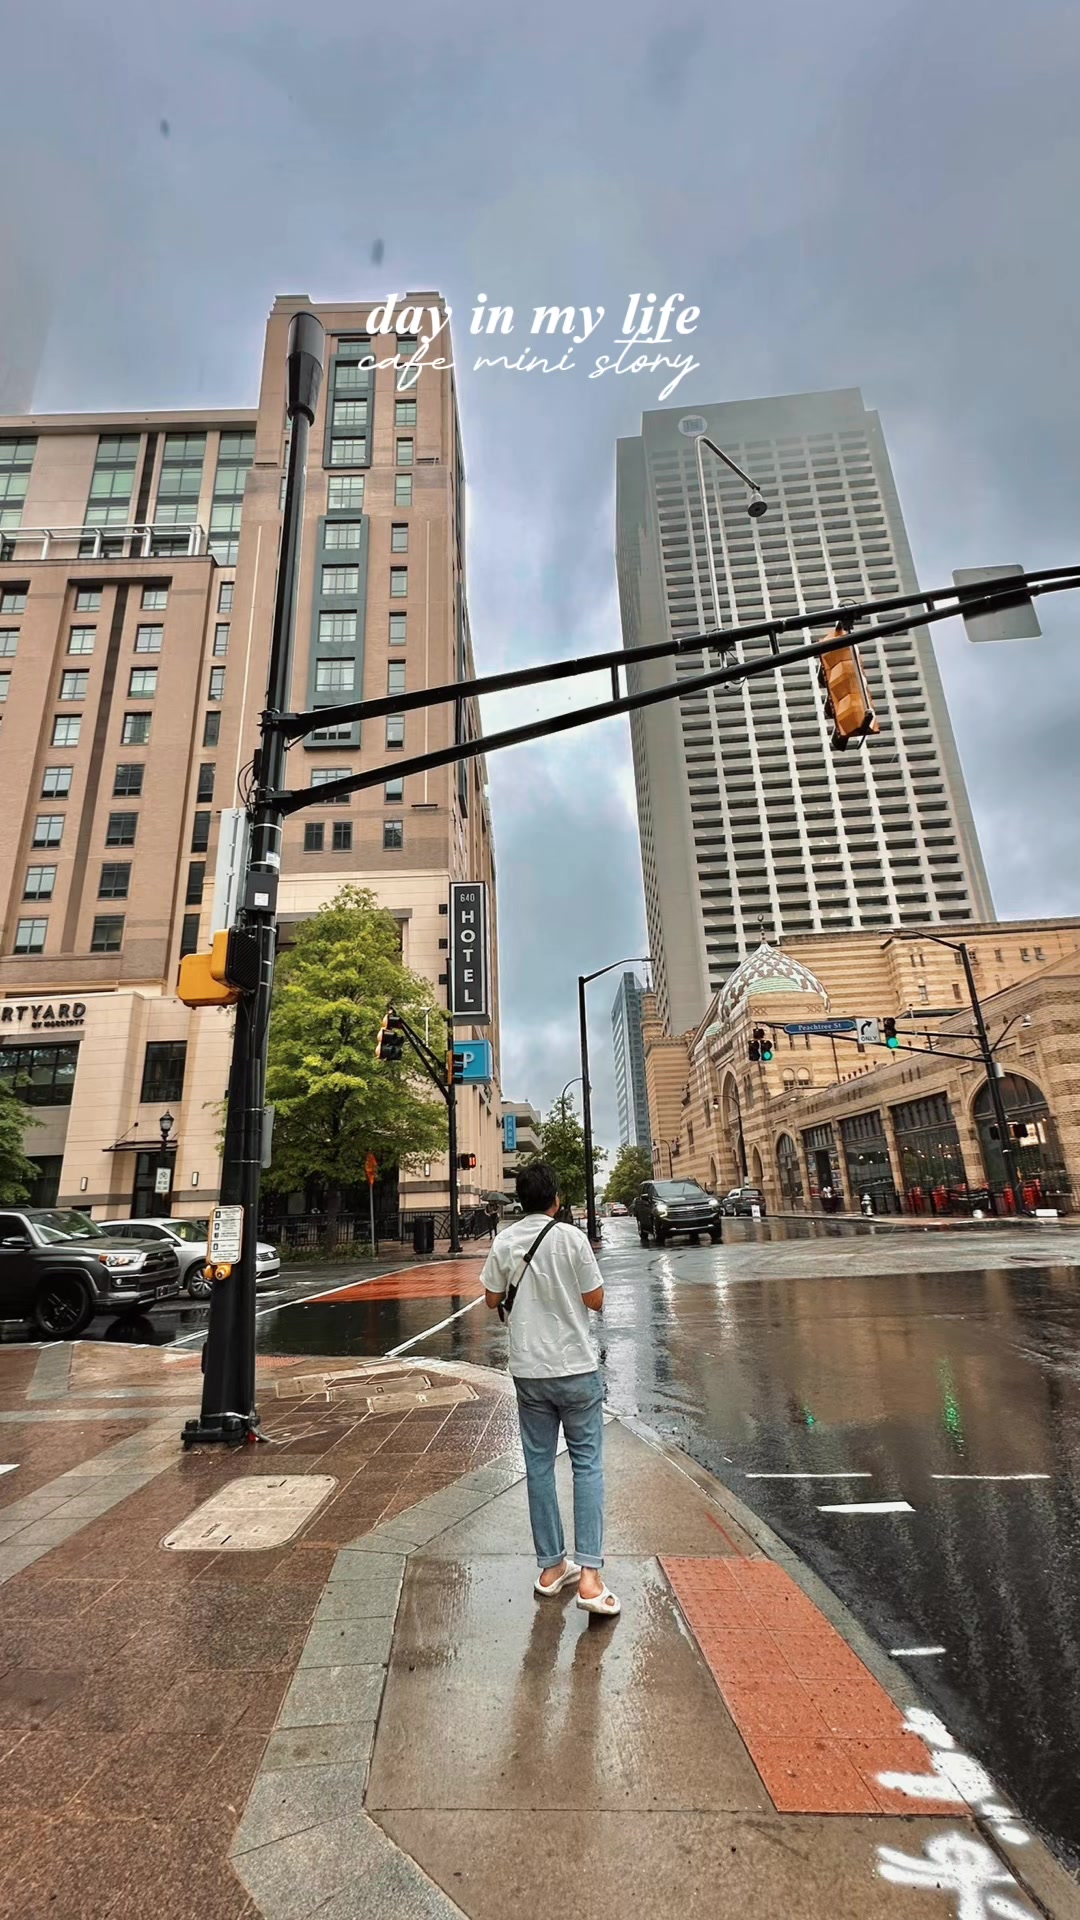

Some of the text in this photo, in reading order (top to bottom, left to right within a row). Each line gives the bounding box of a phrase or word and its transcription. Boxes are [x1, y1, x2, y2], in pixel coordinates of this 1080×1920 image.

[460, 893, 475, 902] 640
[460, 910, 476, 1003] HOTEL
[798, 1023, 832, 1031] Peachtree
[463, 1051, 475, 1068] P
